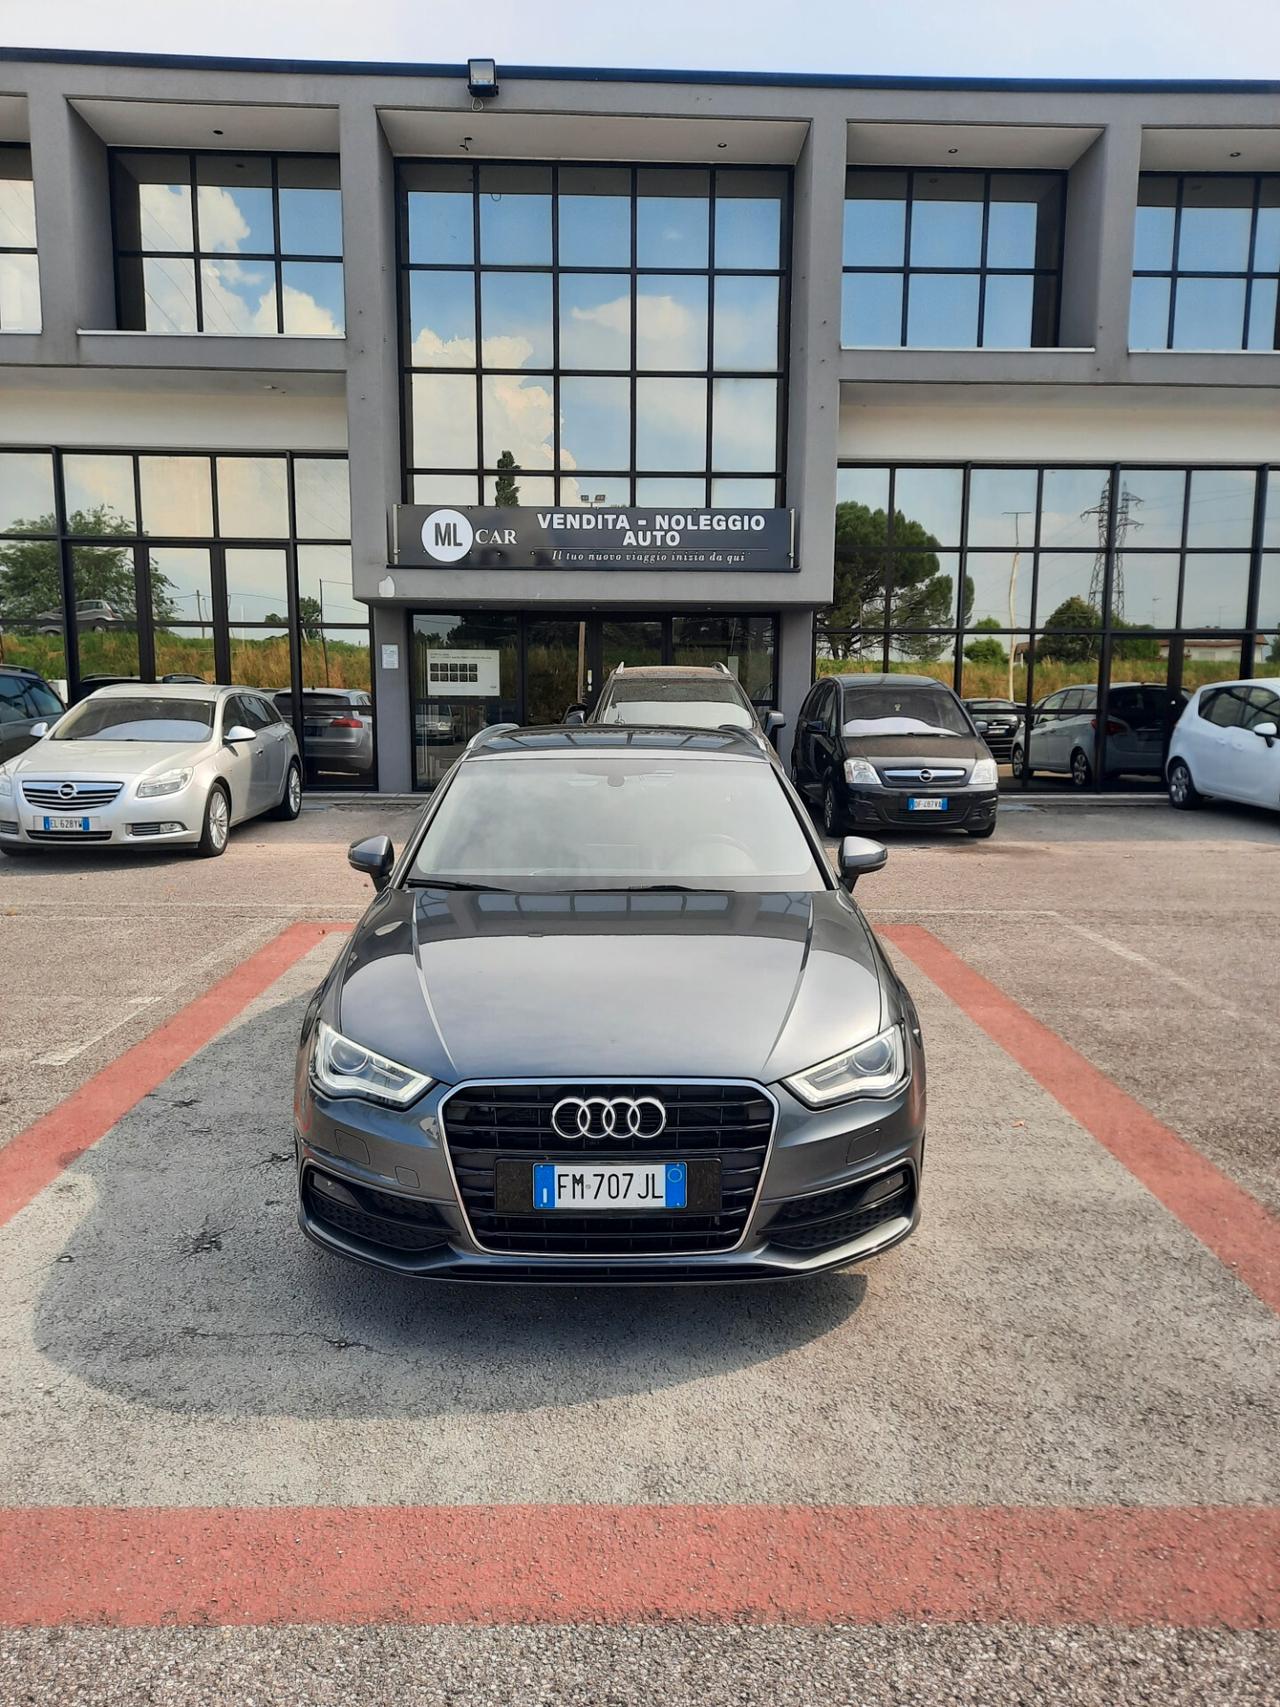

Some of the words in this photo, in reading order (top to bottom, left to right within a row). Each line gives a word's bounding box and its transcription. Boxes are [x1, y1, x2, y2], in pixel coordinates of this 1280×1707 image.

[536, 513, 631, 530] VENDITA
[655, 514, 766, 531] NOLEGGIO
[434, 522, 463, 547] ML
[475, 528, 518, 545] CAR
[622, 530, 681, 547] AUTO
[552, 550, 562, 560] Il
[566, 552, 584, 561] tuo
[588, 553, 622, 561] nuovo
[626, 551, 667, 564] viaggio
[671, 551, 705, 562] inizia
[709, 551, 723, 562] da
[726, 552, 746, 564] qui
[557, 1173, 585, 1200] FM
[593, 1172, 664, 1200] 707JL
